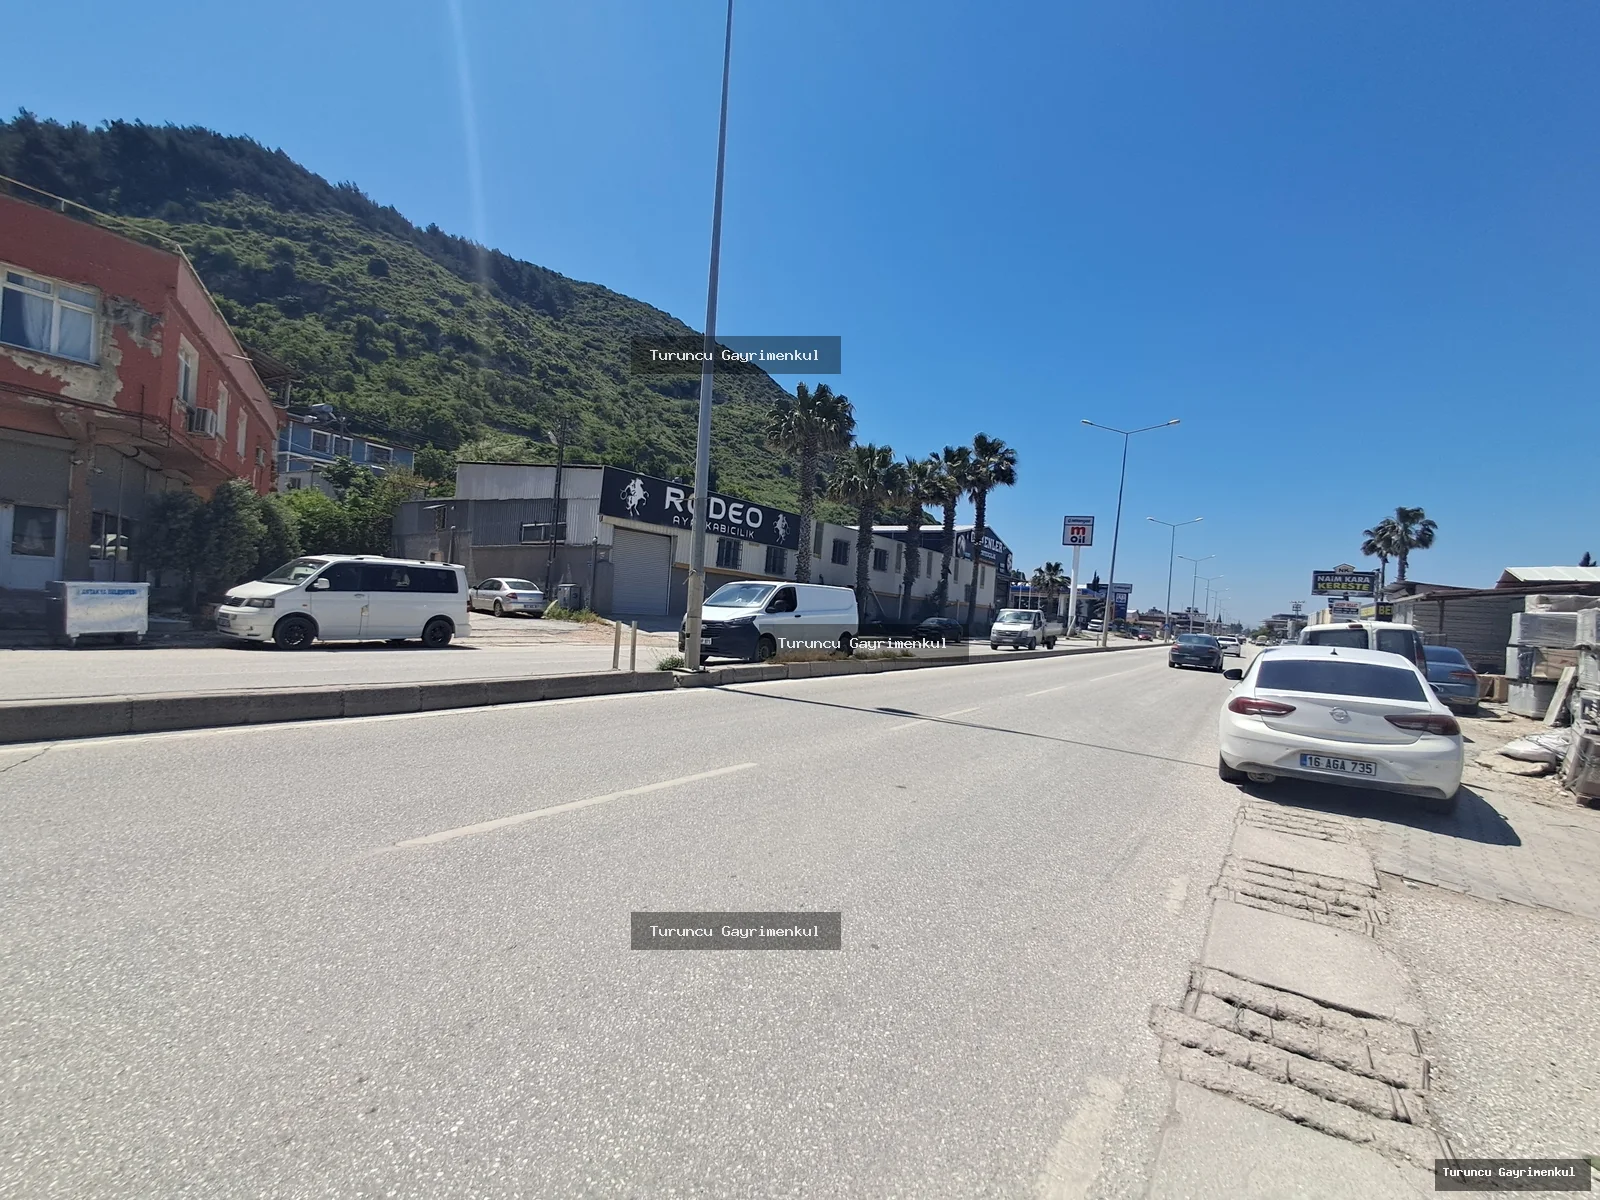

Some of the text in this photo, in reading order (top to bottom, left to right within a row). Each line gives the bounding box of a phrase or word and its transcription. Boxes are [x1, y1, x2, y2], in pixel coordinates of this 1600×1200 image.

[1317, 582, 1370, 591] KERESTE
[1308, 756, 1373, 774] 16 AGA 735
